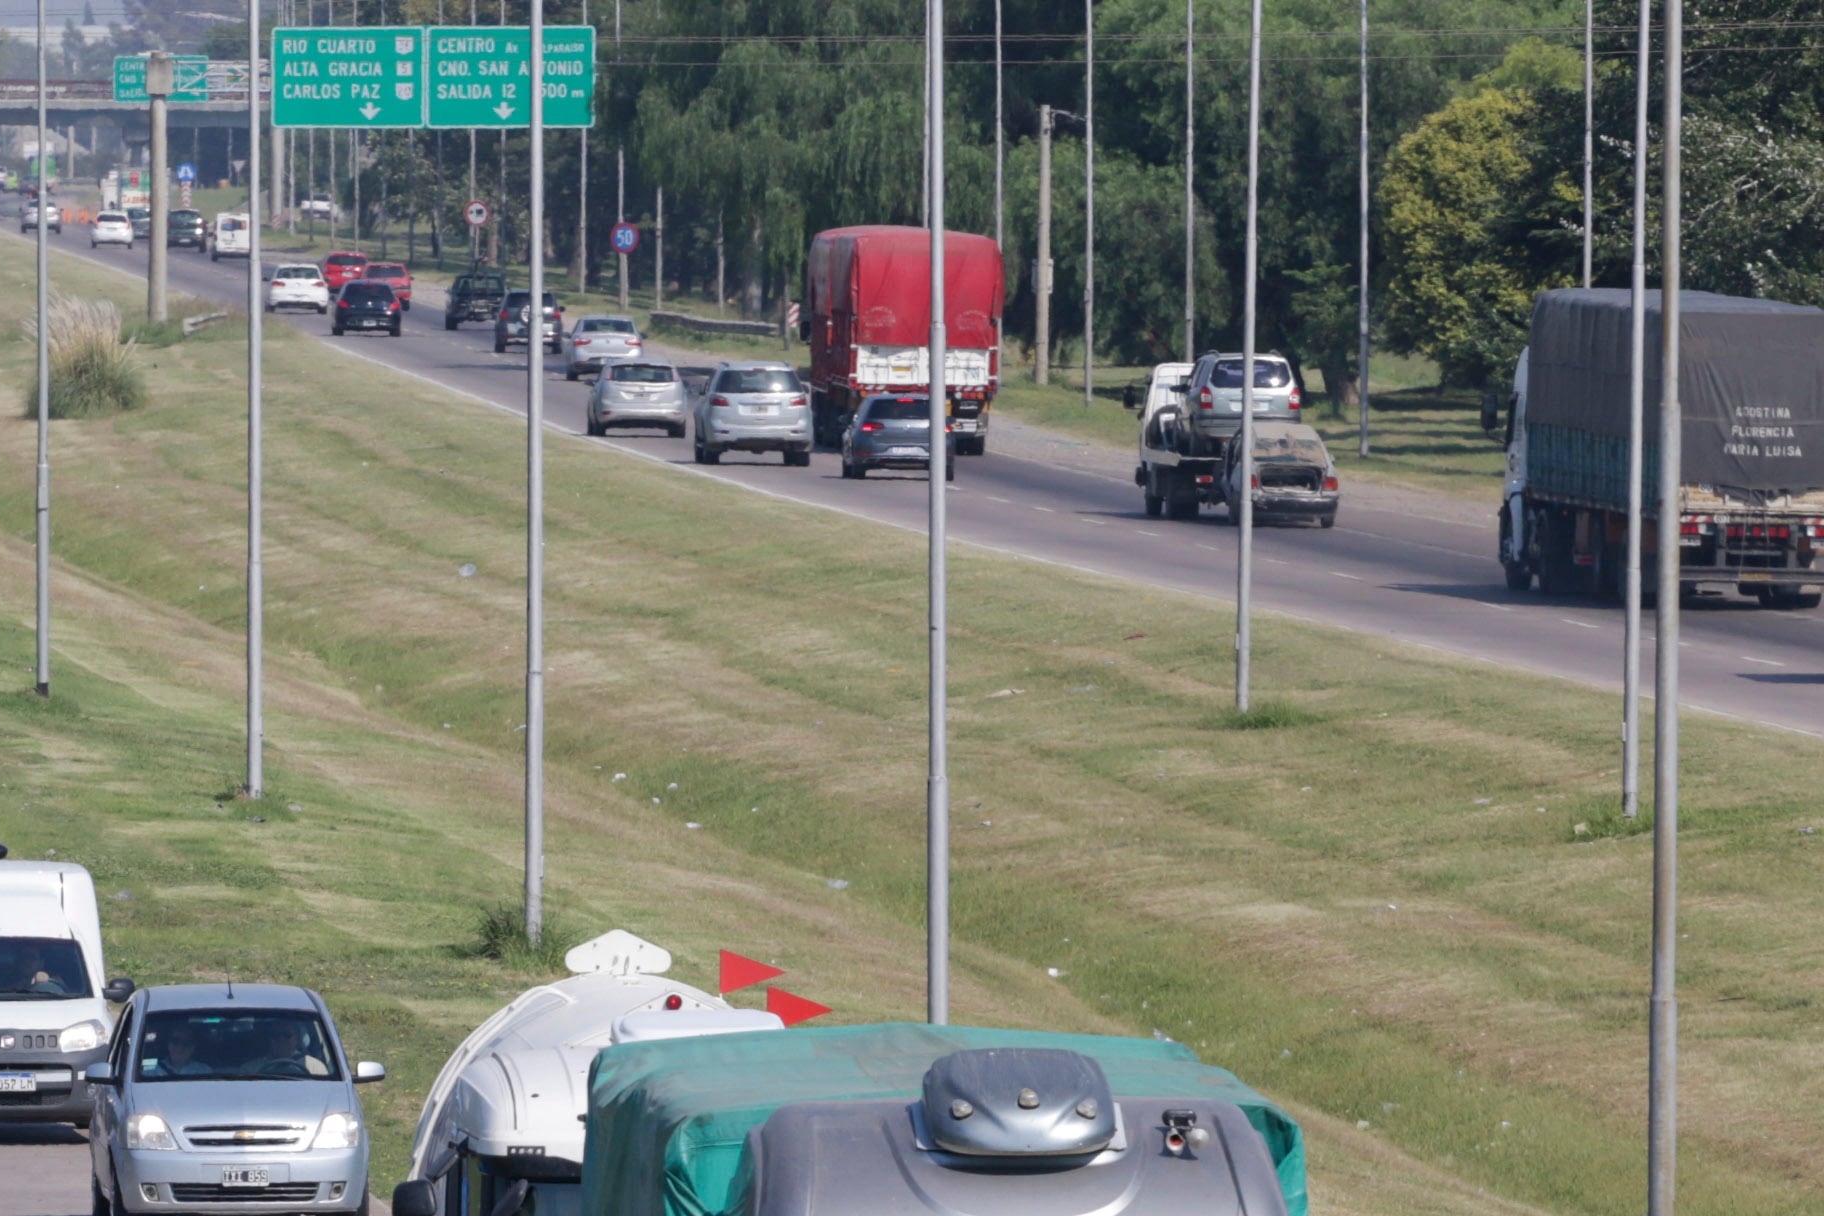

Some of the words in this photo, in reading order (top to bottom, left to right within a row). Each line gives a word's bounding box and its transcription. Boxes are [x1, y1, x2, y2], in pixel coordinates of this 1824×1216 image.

[282, 39, 307, 54] RIO
[317, 39, 376, 54] CUARTO
[437, 38, 495, 53] CENTRO
[119, 62, 146, 71] CENTR
[283, 61, 319, 76] ALTA
[328, 61, 383, 76] GRACIA
[437, 61, 472, 76] CNO.
[478, 61, 509, 76] SAN
[283, 84, 340, 99] CARLOS
[351, 84, 381, 99] PAZ
[437, 84, 492, 99] SALIDA
[502, 83, 516, 98] 12
[616, 229, 633, 247] 50
[1765, 445, 1802, 457] LUISA
[248, 1170, 267, 1182] 859
